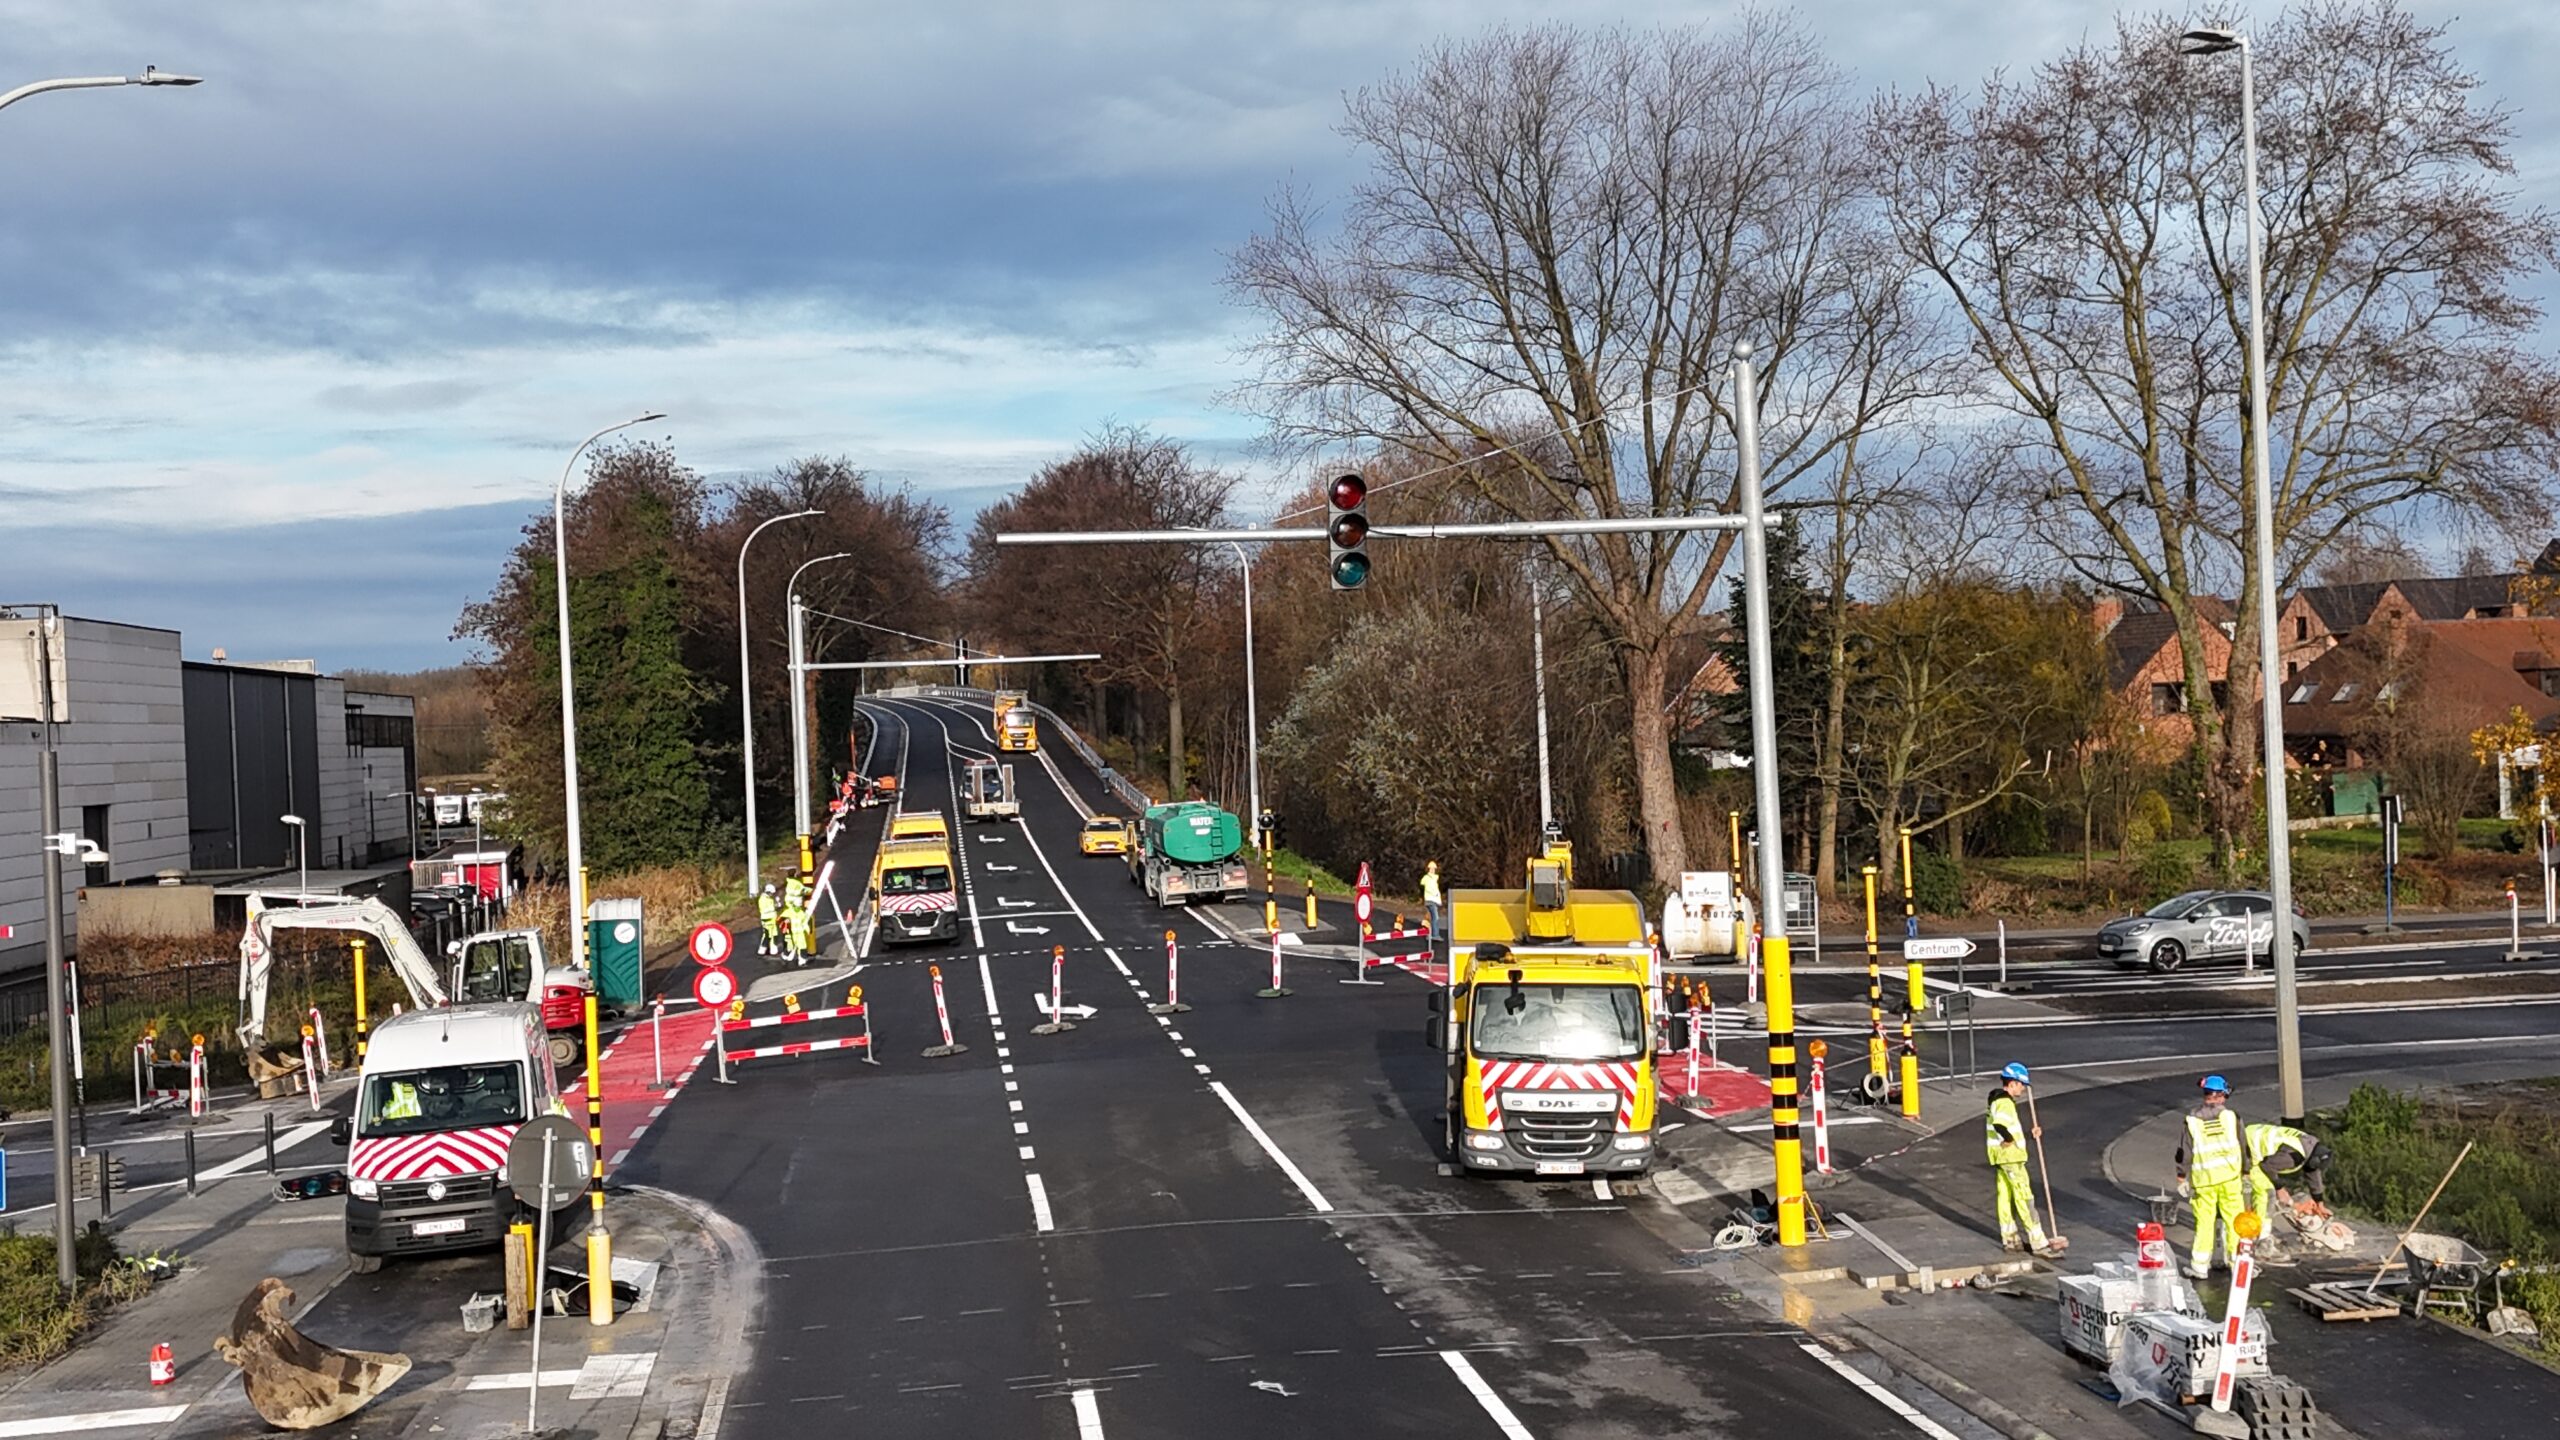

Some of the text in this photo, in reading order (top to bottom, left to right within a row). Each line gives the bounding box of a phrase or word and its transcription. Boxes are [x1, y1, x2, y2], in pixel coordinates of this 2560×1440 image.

[2204, 916, 2274, 946] Ford
[1910, 944, 1961, 956] Centrum
[1538, 1100, 1581, 1108] DAF
